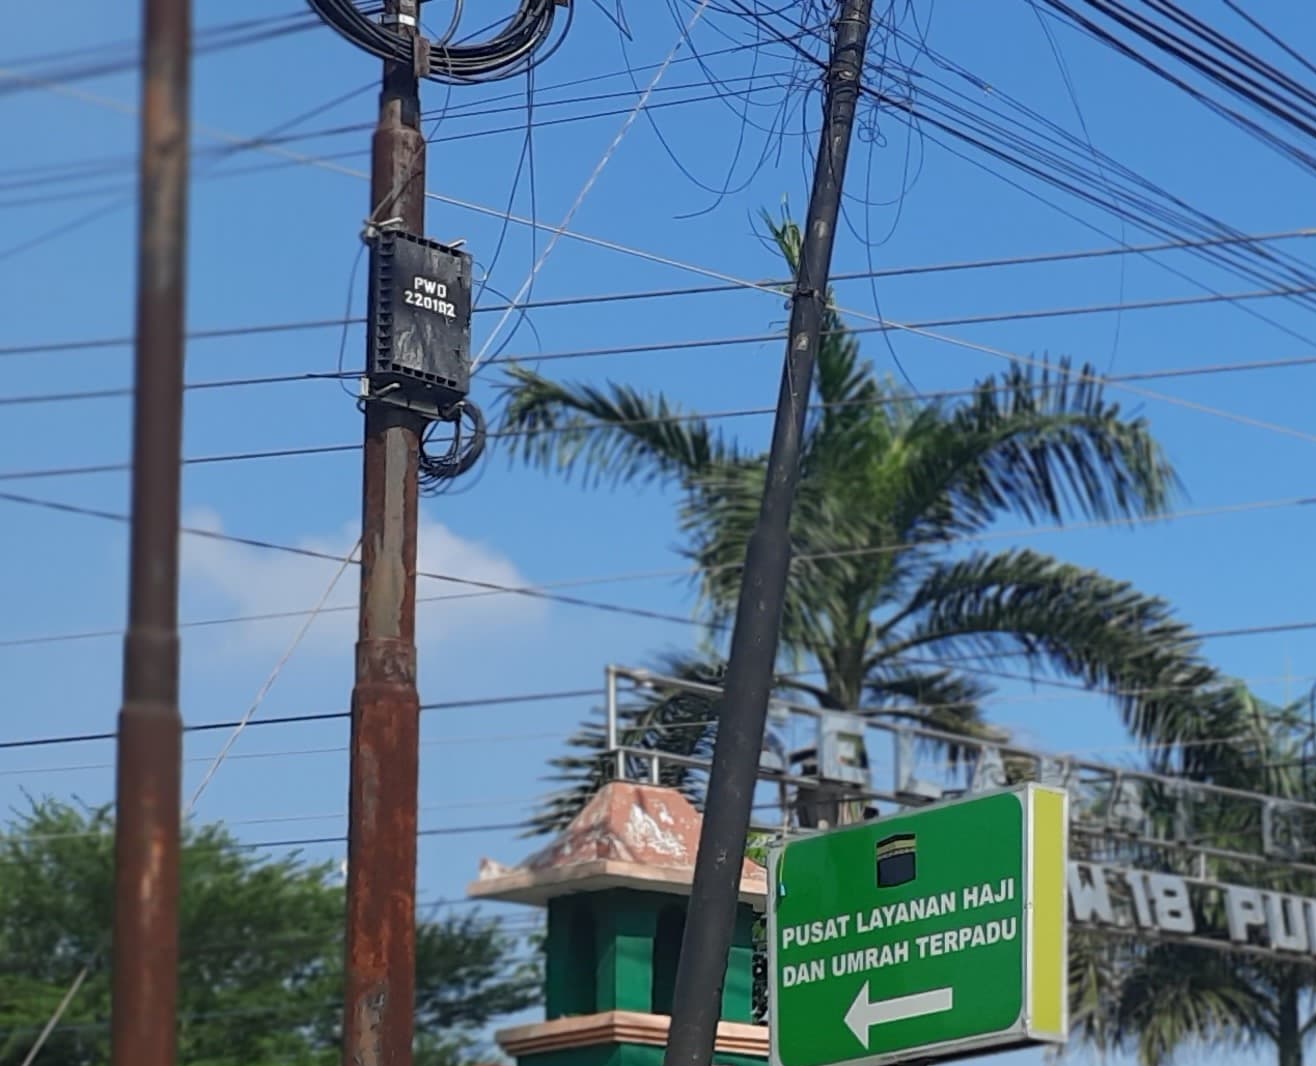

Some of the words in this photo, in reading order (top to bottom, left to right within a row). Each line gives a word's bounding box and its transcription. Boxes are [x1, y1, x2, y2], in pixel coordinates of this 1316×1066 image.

[782, 915, 850, 949] PUSAT
[856, 892, 956, 934] LAYANAN
[963, 878, 1014, 910] HAJI
[783, 959, 825, 987] DAN
[832, 942, 909, 977] UMRAH
[916, 917, 1017, 958] TERPADU
